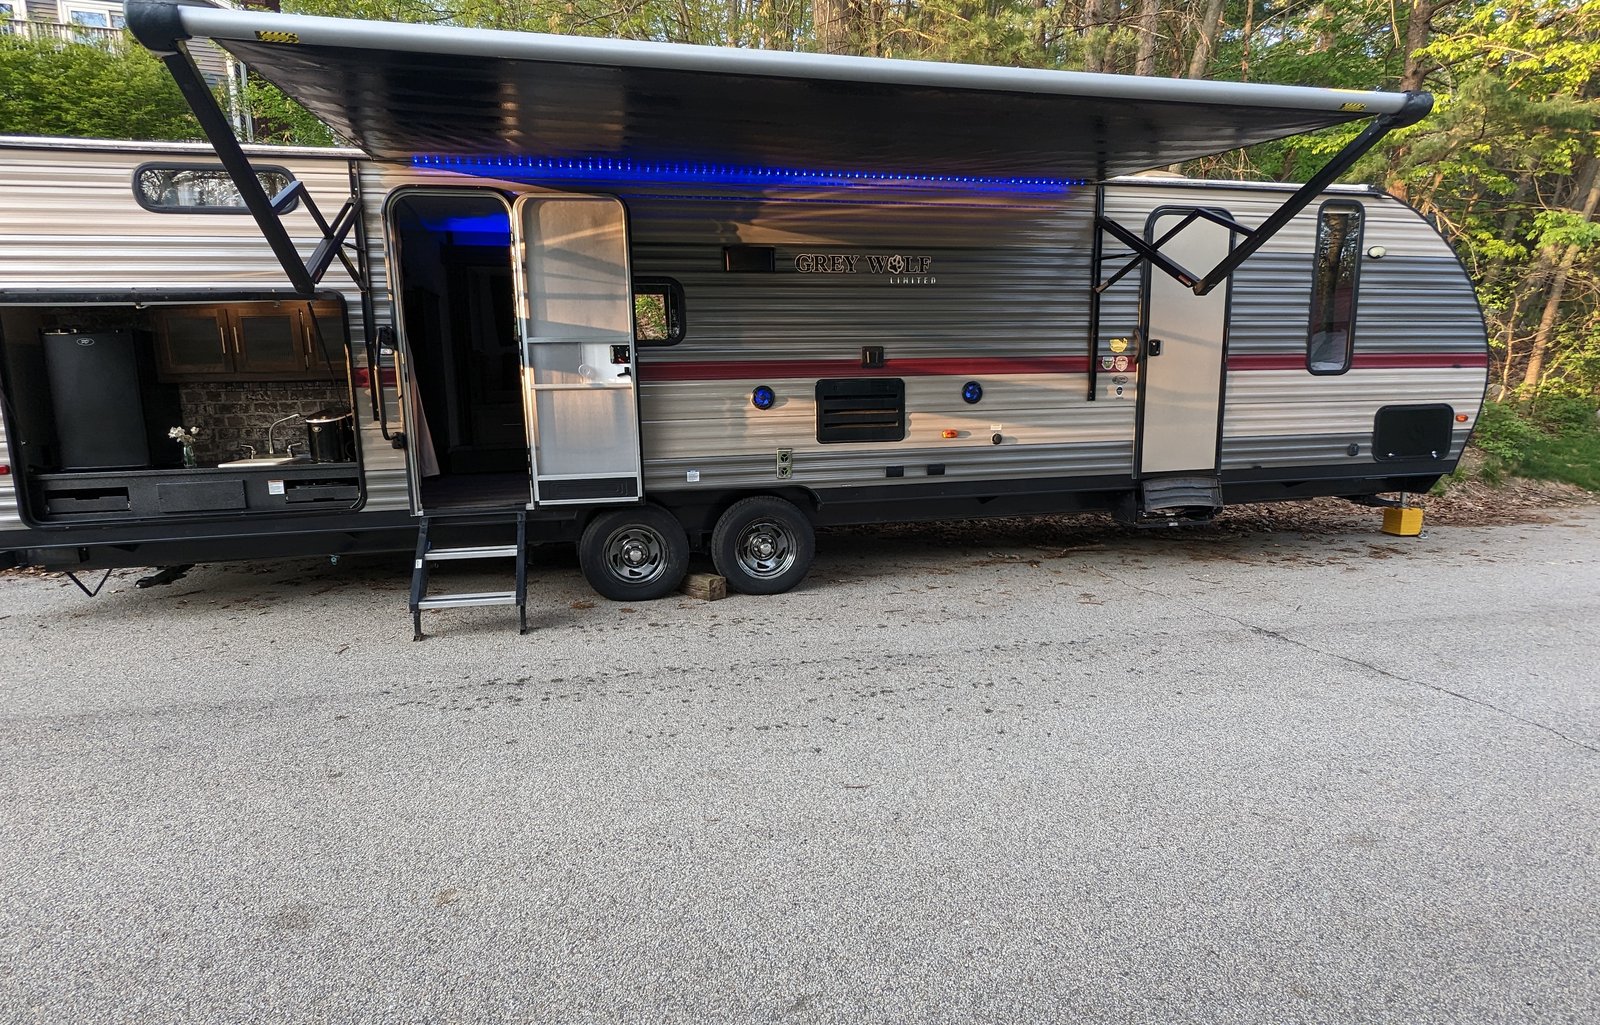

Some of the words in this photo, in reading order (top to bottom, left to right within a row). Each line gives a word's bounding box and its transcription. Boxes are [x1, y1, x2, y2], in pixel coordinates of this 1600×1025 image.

[794, 253, 860, 274] GREY
[865, 254, 932, 275] WOLF
[890, 276, 937, 285] LIMITED
